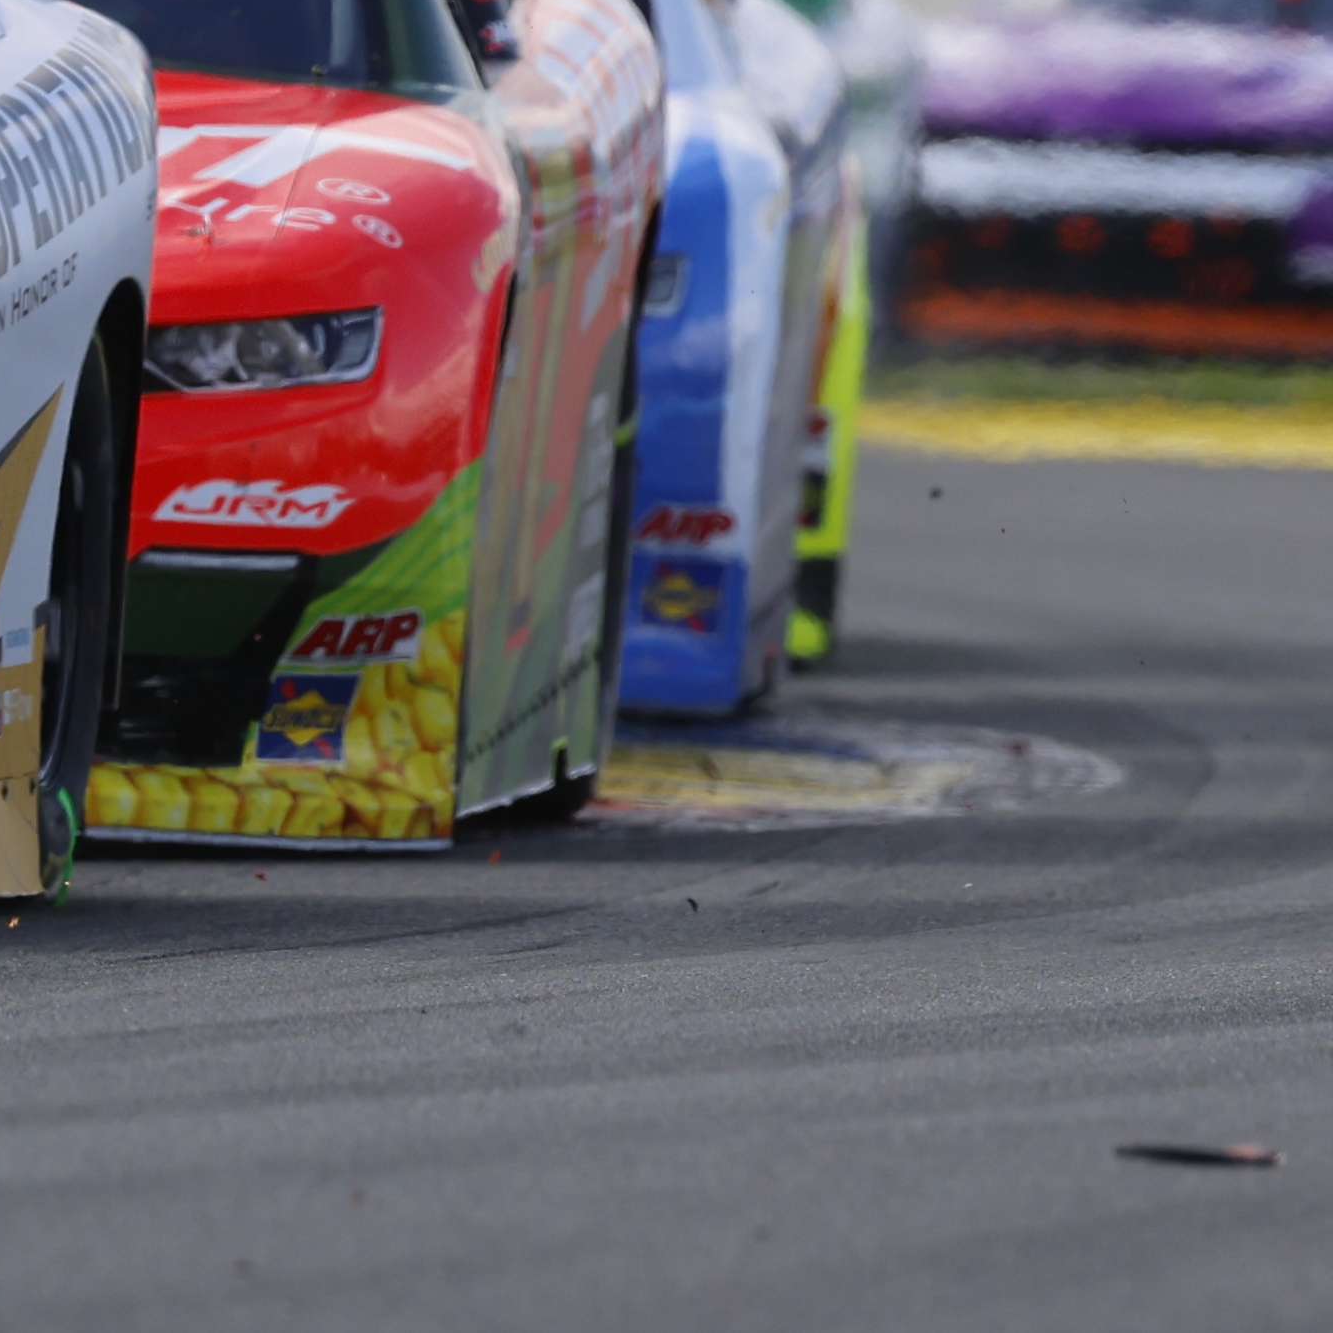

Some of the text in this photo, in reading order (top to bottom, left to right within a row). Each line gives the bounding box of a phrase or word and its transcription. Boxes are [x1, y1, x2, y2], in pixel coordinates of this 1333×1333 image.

[11, 267, 58, 326] HONOR
[172, 493, 330, 526] JRM
[287, 611, 421, 658] ARP
